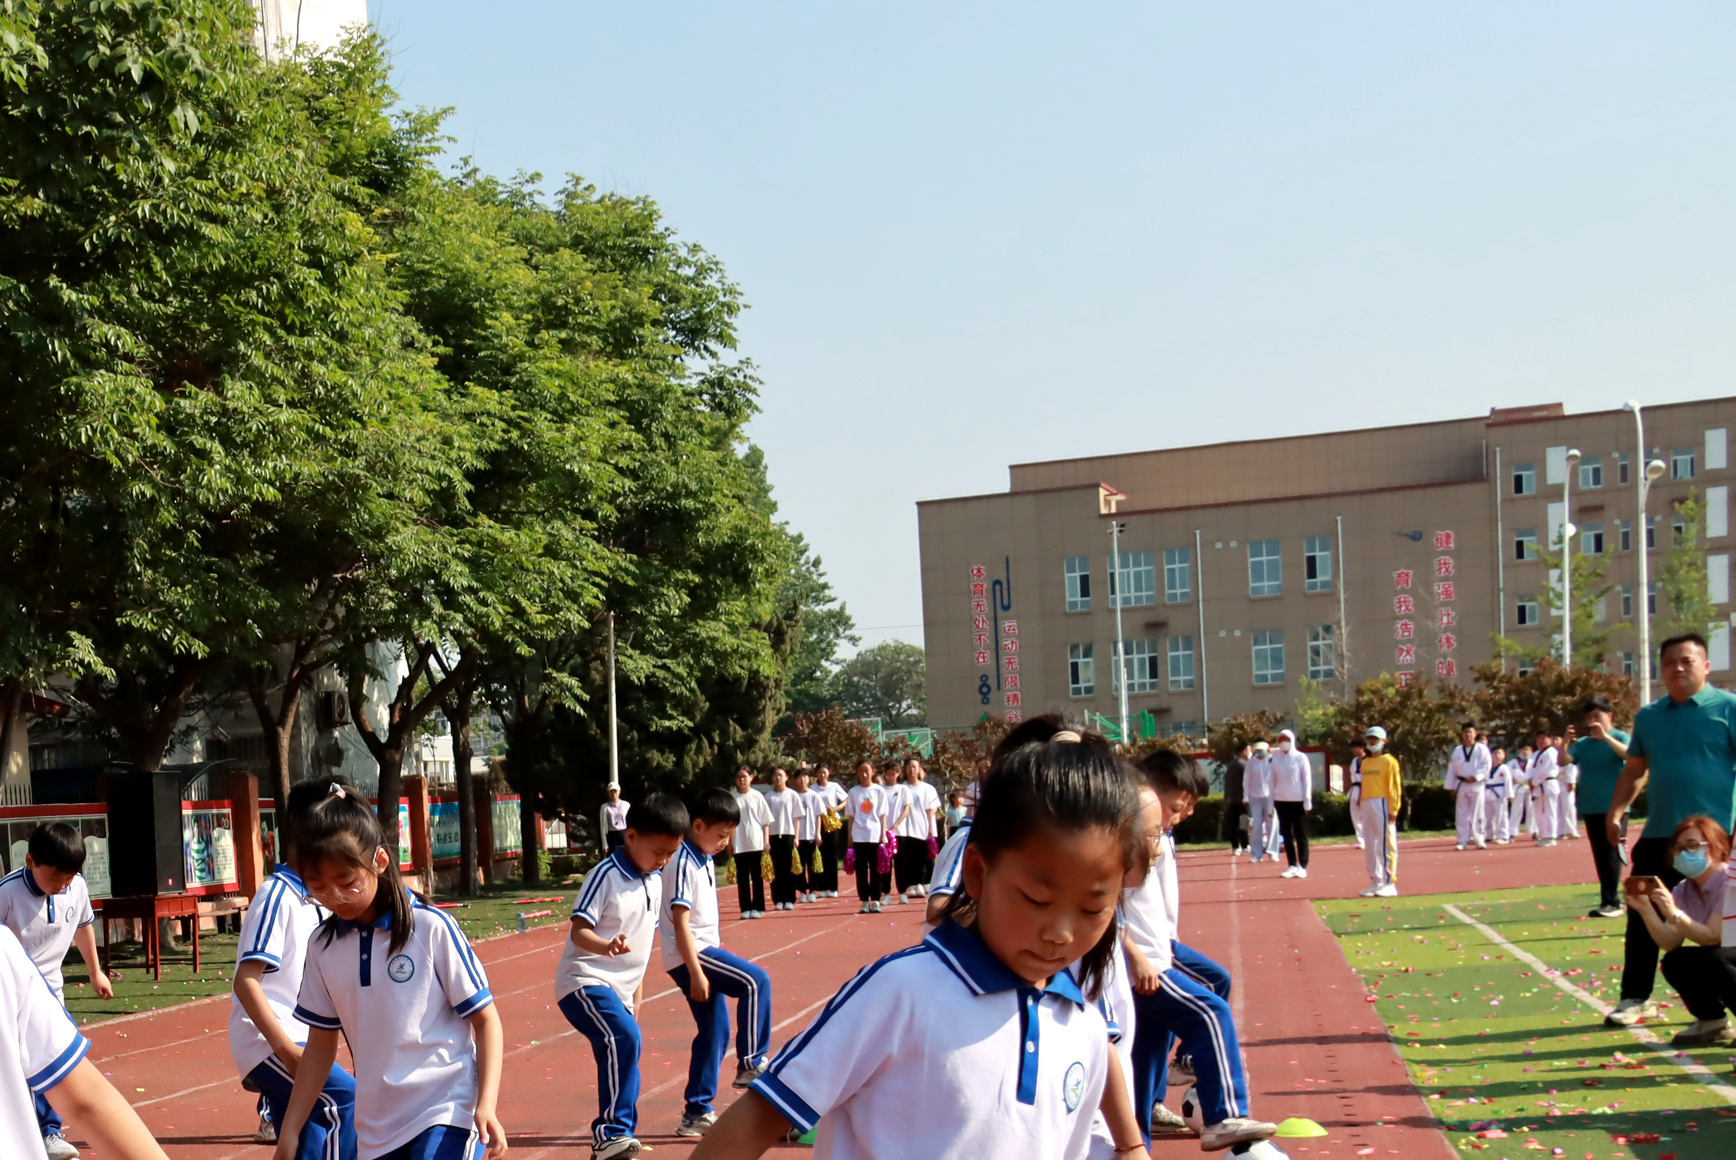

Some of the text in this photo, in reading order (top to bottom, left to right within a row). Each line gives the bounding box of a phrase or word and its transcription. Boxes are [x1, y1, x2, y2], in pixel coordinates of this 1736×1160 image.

[970, 564, 990, 665] 体育无处不在
[1003, 620, 1023, 724] 运动无限精彩
